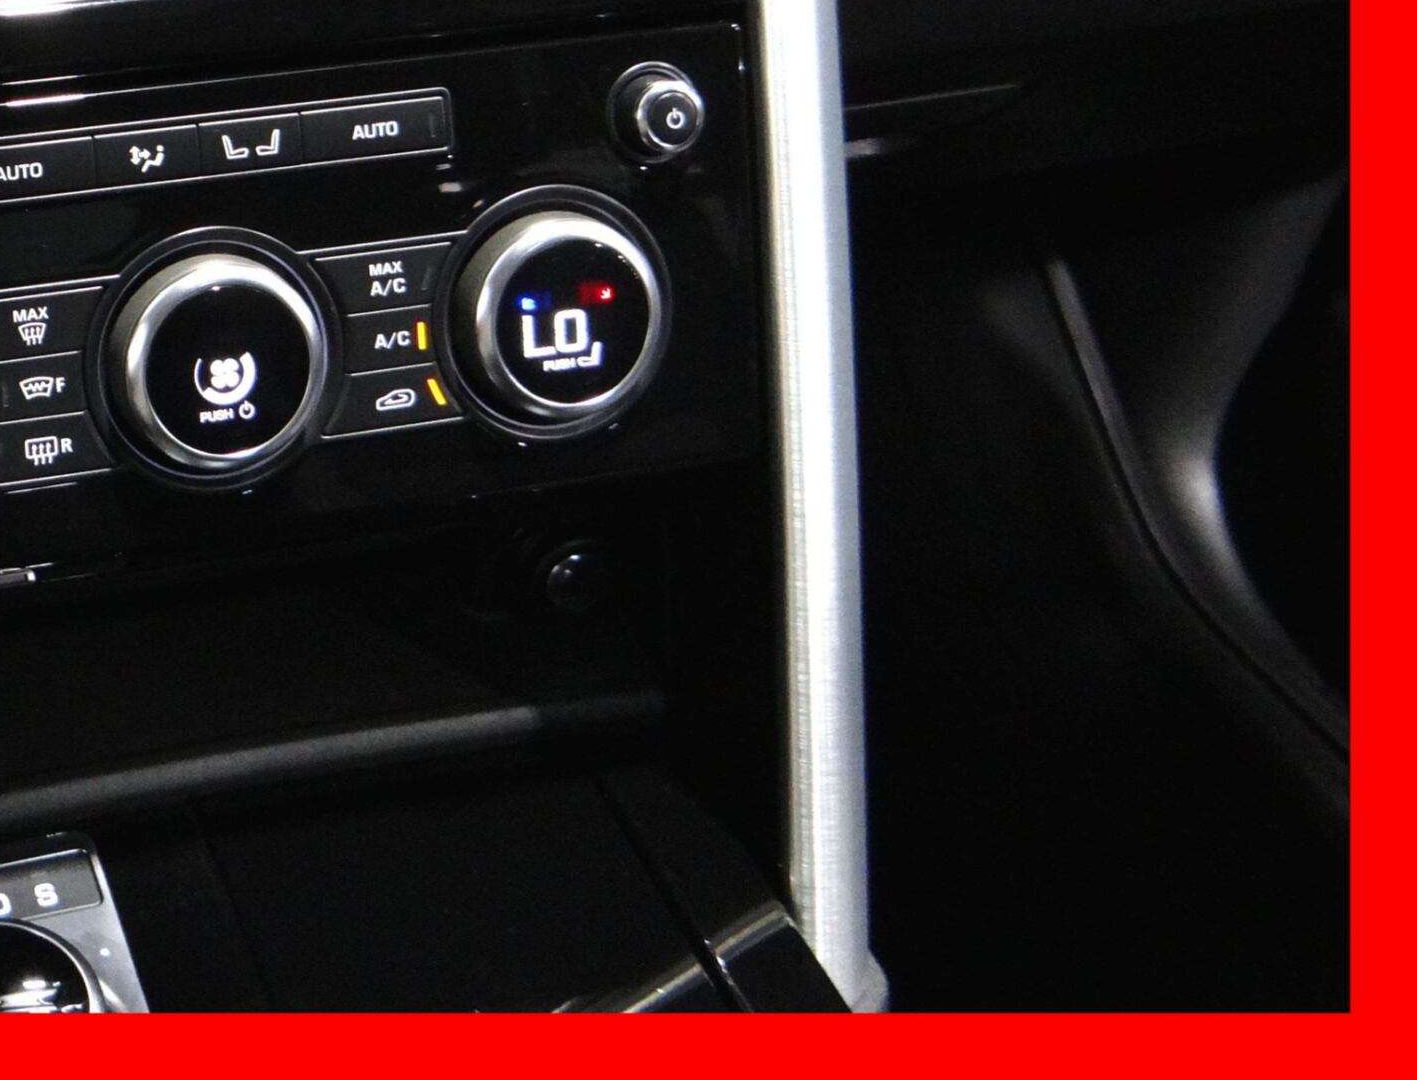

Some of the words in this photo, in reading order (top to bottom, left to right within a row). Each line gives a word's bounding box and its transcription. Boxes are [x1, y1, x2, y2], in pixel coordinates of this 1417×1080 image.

[352, 121, 398, 141] AUTO
[369, 260, 403, 276] MAX
[370, 277, 406, 296] A/C
[12, 306, 49, 323] MAX
[374, 330, 410, 350] A/C
[522, 309, 589, 359] LO
[543, 357, 577, 371] PUSH
[55, 376, 66, 393] F
[200, 407, 234, 422] PUSH
[60, 438, 73, 454] R
[34, 882, 58, 907] S
